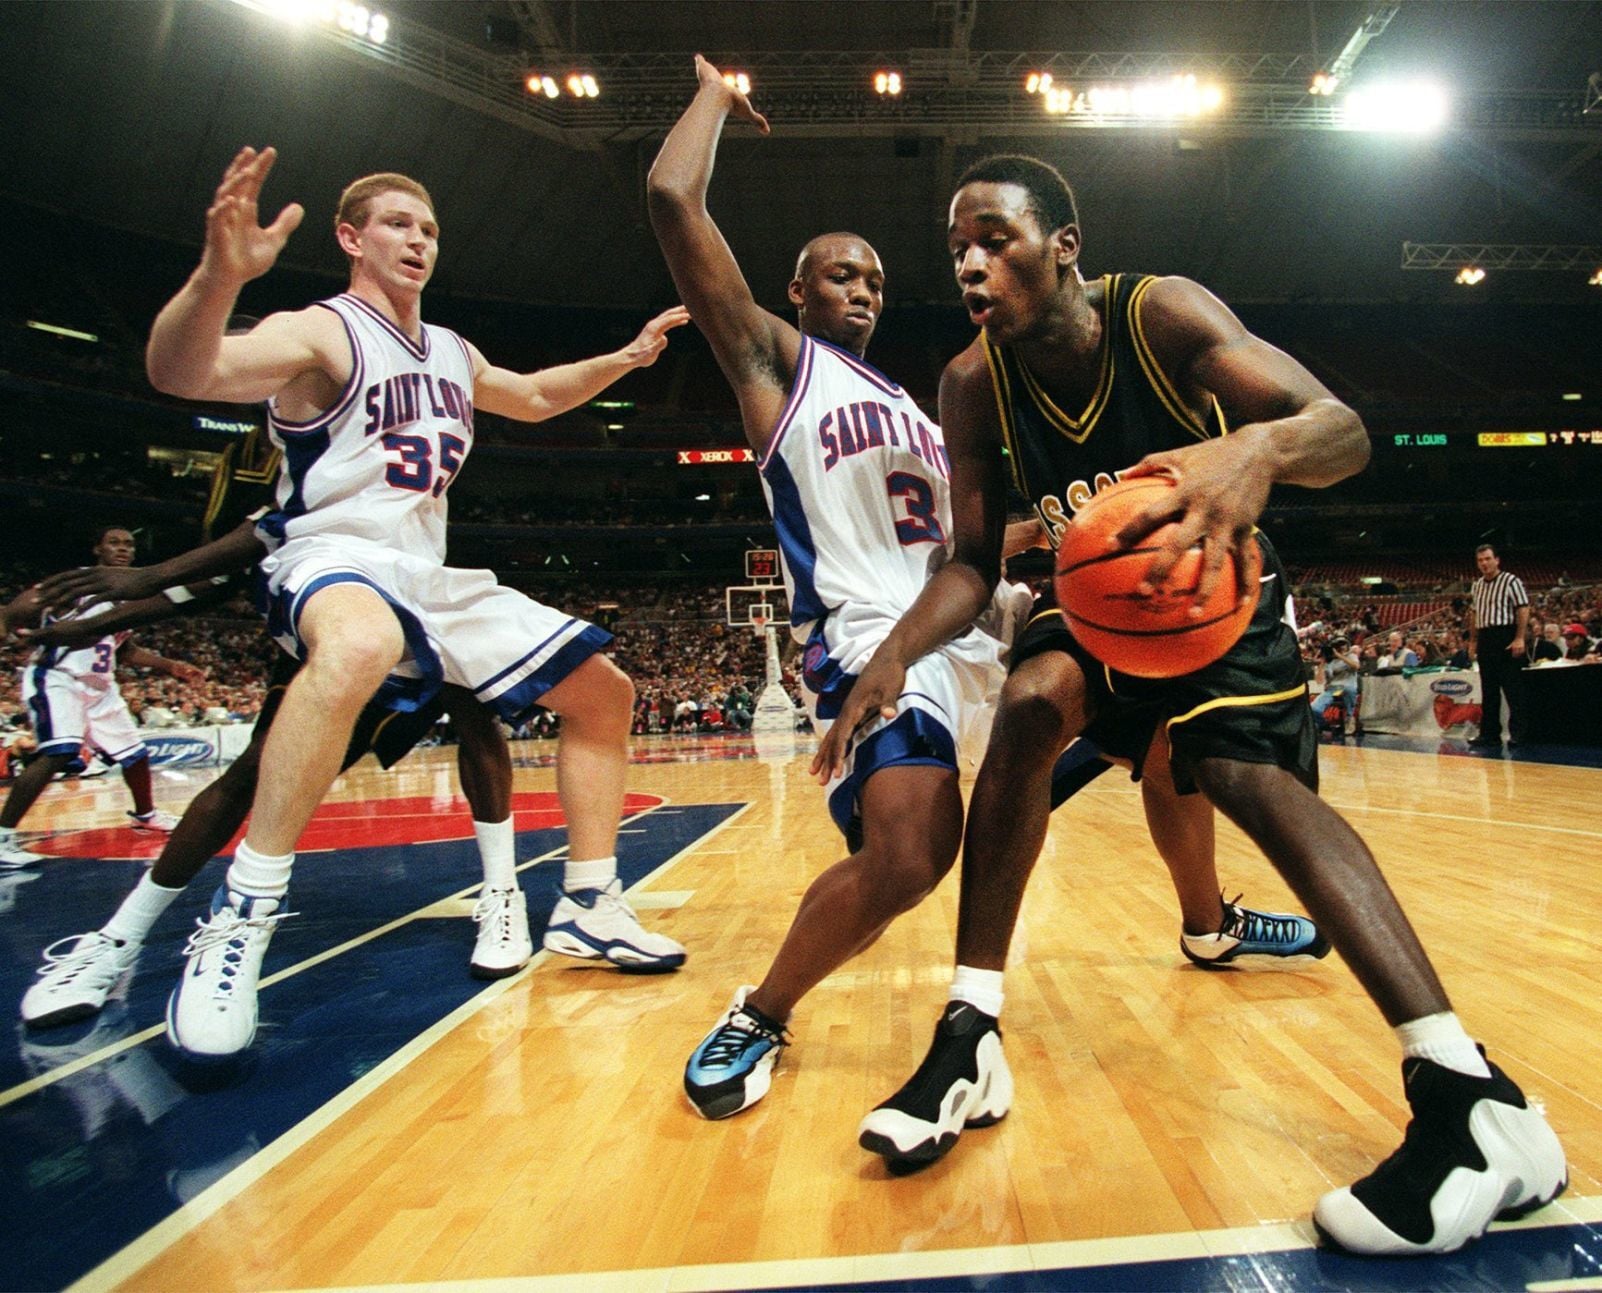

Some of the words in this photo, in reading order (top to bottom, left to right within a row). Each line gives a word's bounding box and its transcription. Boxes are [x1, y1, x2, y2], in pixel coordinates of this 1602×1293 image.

[365, 373, 421, 437] SAINT
[818, 400, 899, 473] SAINT
[380, 432, 465, 499] 35
[700, 451, 733, 462] XEROX
[1394, 434, 1414, 446] ST.
[1416, 434, 1447, 446] LOUIS
[886, 471, 947, 546] 3
[91, 643, 111, 673] 3
